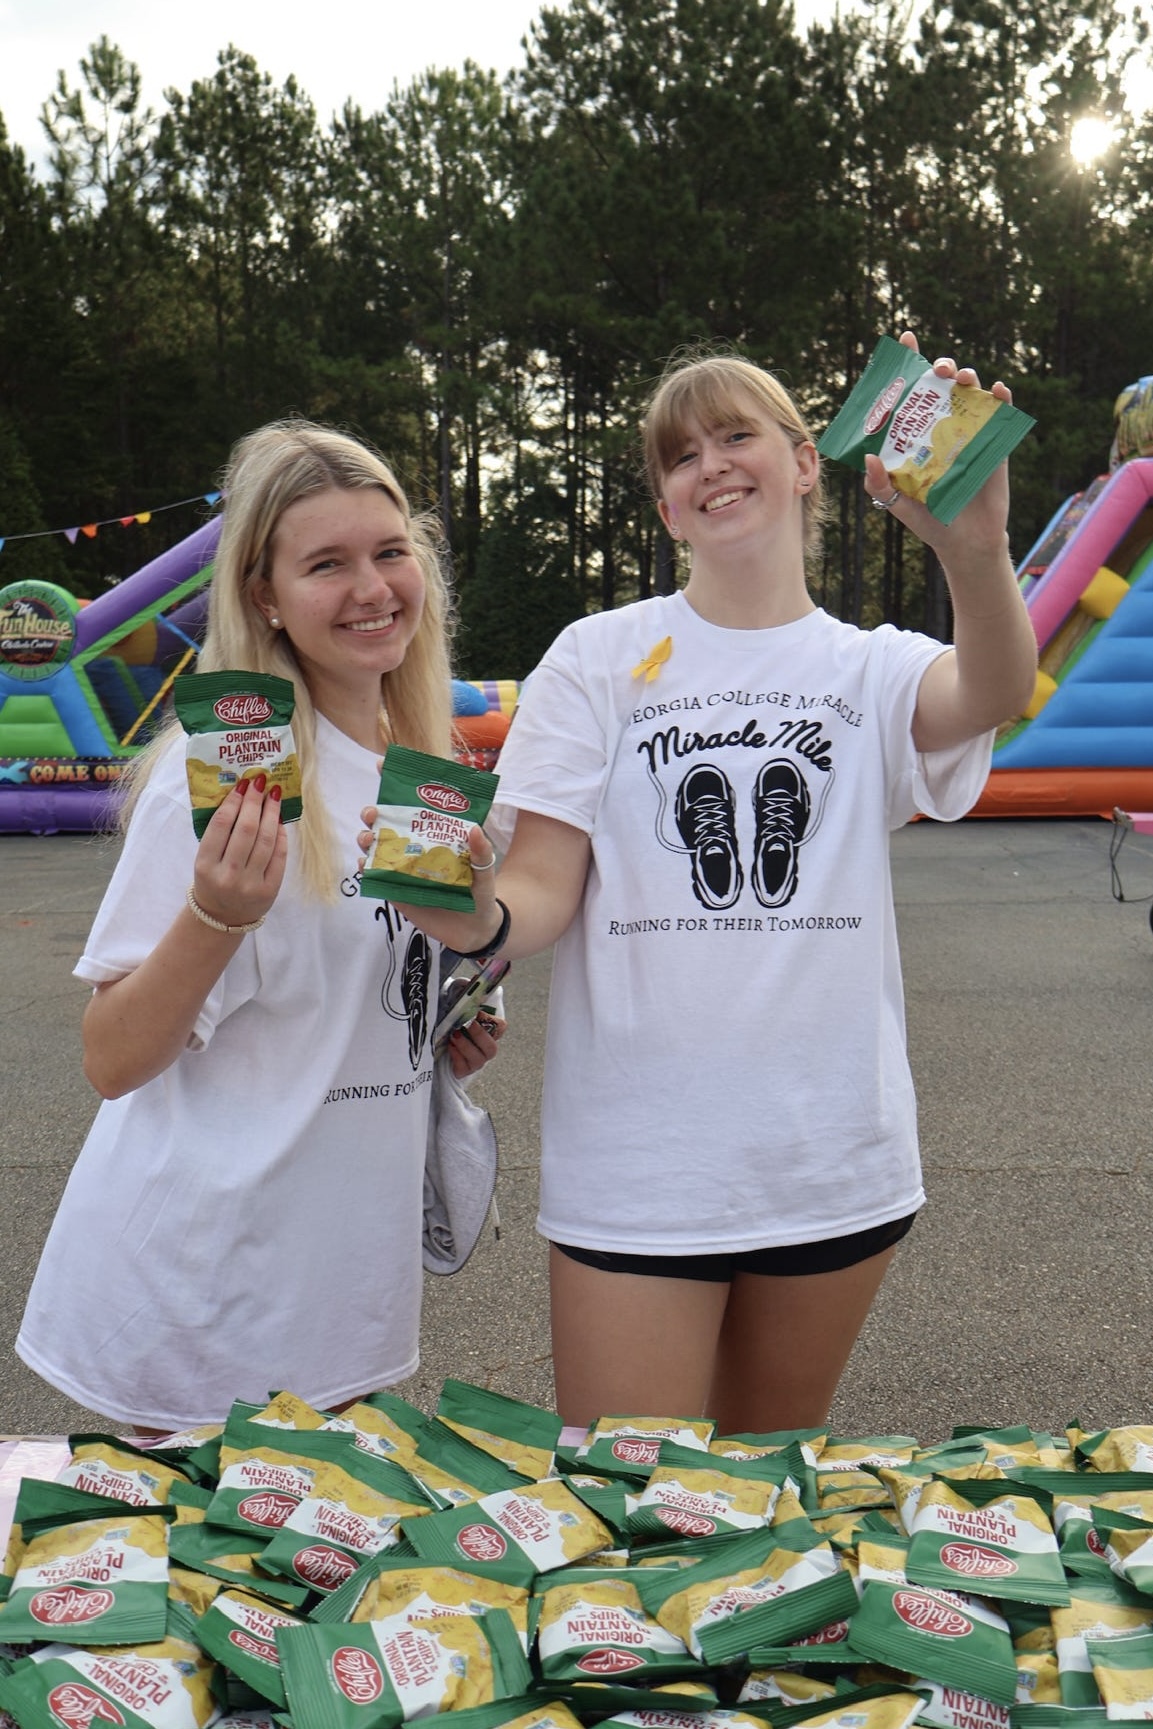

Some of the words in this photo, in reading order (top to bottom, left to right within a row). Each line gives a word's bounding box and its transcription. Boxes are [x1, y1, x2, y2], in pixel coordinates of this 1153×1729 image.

[889, 391, 923, 440] ORIGINAL
[894, 389, 941, 454] PLANTAIN
[912, 411, 935, 438] CHIPS
[217, 697, 271, 724] Chifles
[627, 697, 703, 725] EORGIA
[706, 691, 791, 708] COLLEGE
[796, 694, 864, 727] MIRACLE
[219, 740, 282, 759] PLANTAIN
[226, 730, 273, 743] ORIGINAL
[637, 719, 768, 773] Miracle
[768, 719, 833, 772] Mile
[236, 753, 264, 763] CHIPS
[30, 765, 90, 783] COME
[411, 820, 469, 843] PLANTAIN
[426, 831, 455, 843] CHIPS
[608, 918, 671, 936] RUNNING
[677, 919, 708, 932] FOR
[713, 918, 763, 932] THEIR
[767, 917, 862, 932] TOMORROW
[324, 1084, 390, 1104] RUNNING
[617, 1441, 659, 1464] hifles
[99, 1474, 133, 1491] CHIPS
[241, 1465, 312, 1493] PLANTAIN
[262, 1464, 295, 1480] CHIPS
[75, 1473, 149, 1506] PLANTAIN
[249, 1476, 303, 1496] ORIGINAL
[523, 1505, 545, 1524] CHIPS
[654, 1491, 728, 1514] PLANTAIN
[662, 1497, 716, 1515] ORIGINAL
[497, 1511, 528, 1540] ORIGINAL
[504, 1500, 549, 1543] PLANTAIN
[937, 1508, 1017, 1538] PLANTAIN
[948, 1521, 1009, 1545] ORIGINAL
[317, 1523, 367, 1549] ORIGINAL
[459, 1525, 505, 1560] Chifles
[945, 1546, 1013, 1574] Chifles
[37, 1587, 107, 1622] Chifles
[898, 1594, 967, 1633] Chifles
[244, 1615, 276, 1640] INAL
[579, 1632, 644, 1644] ORIGINAL
[336, 1650, 377, 1701] Chifles
[384, 1640, 410, 1686] ORIGINAL
[89, 1665, 147, 1710] ORIGINAL
[942, 1687, 1010, 1724] ANTAIN
